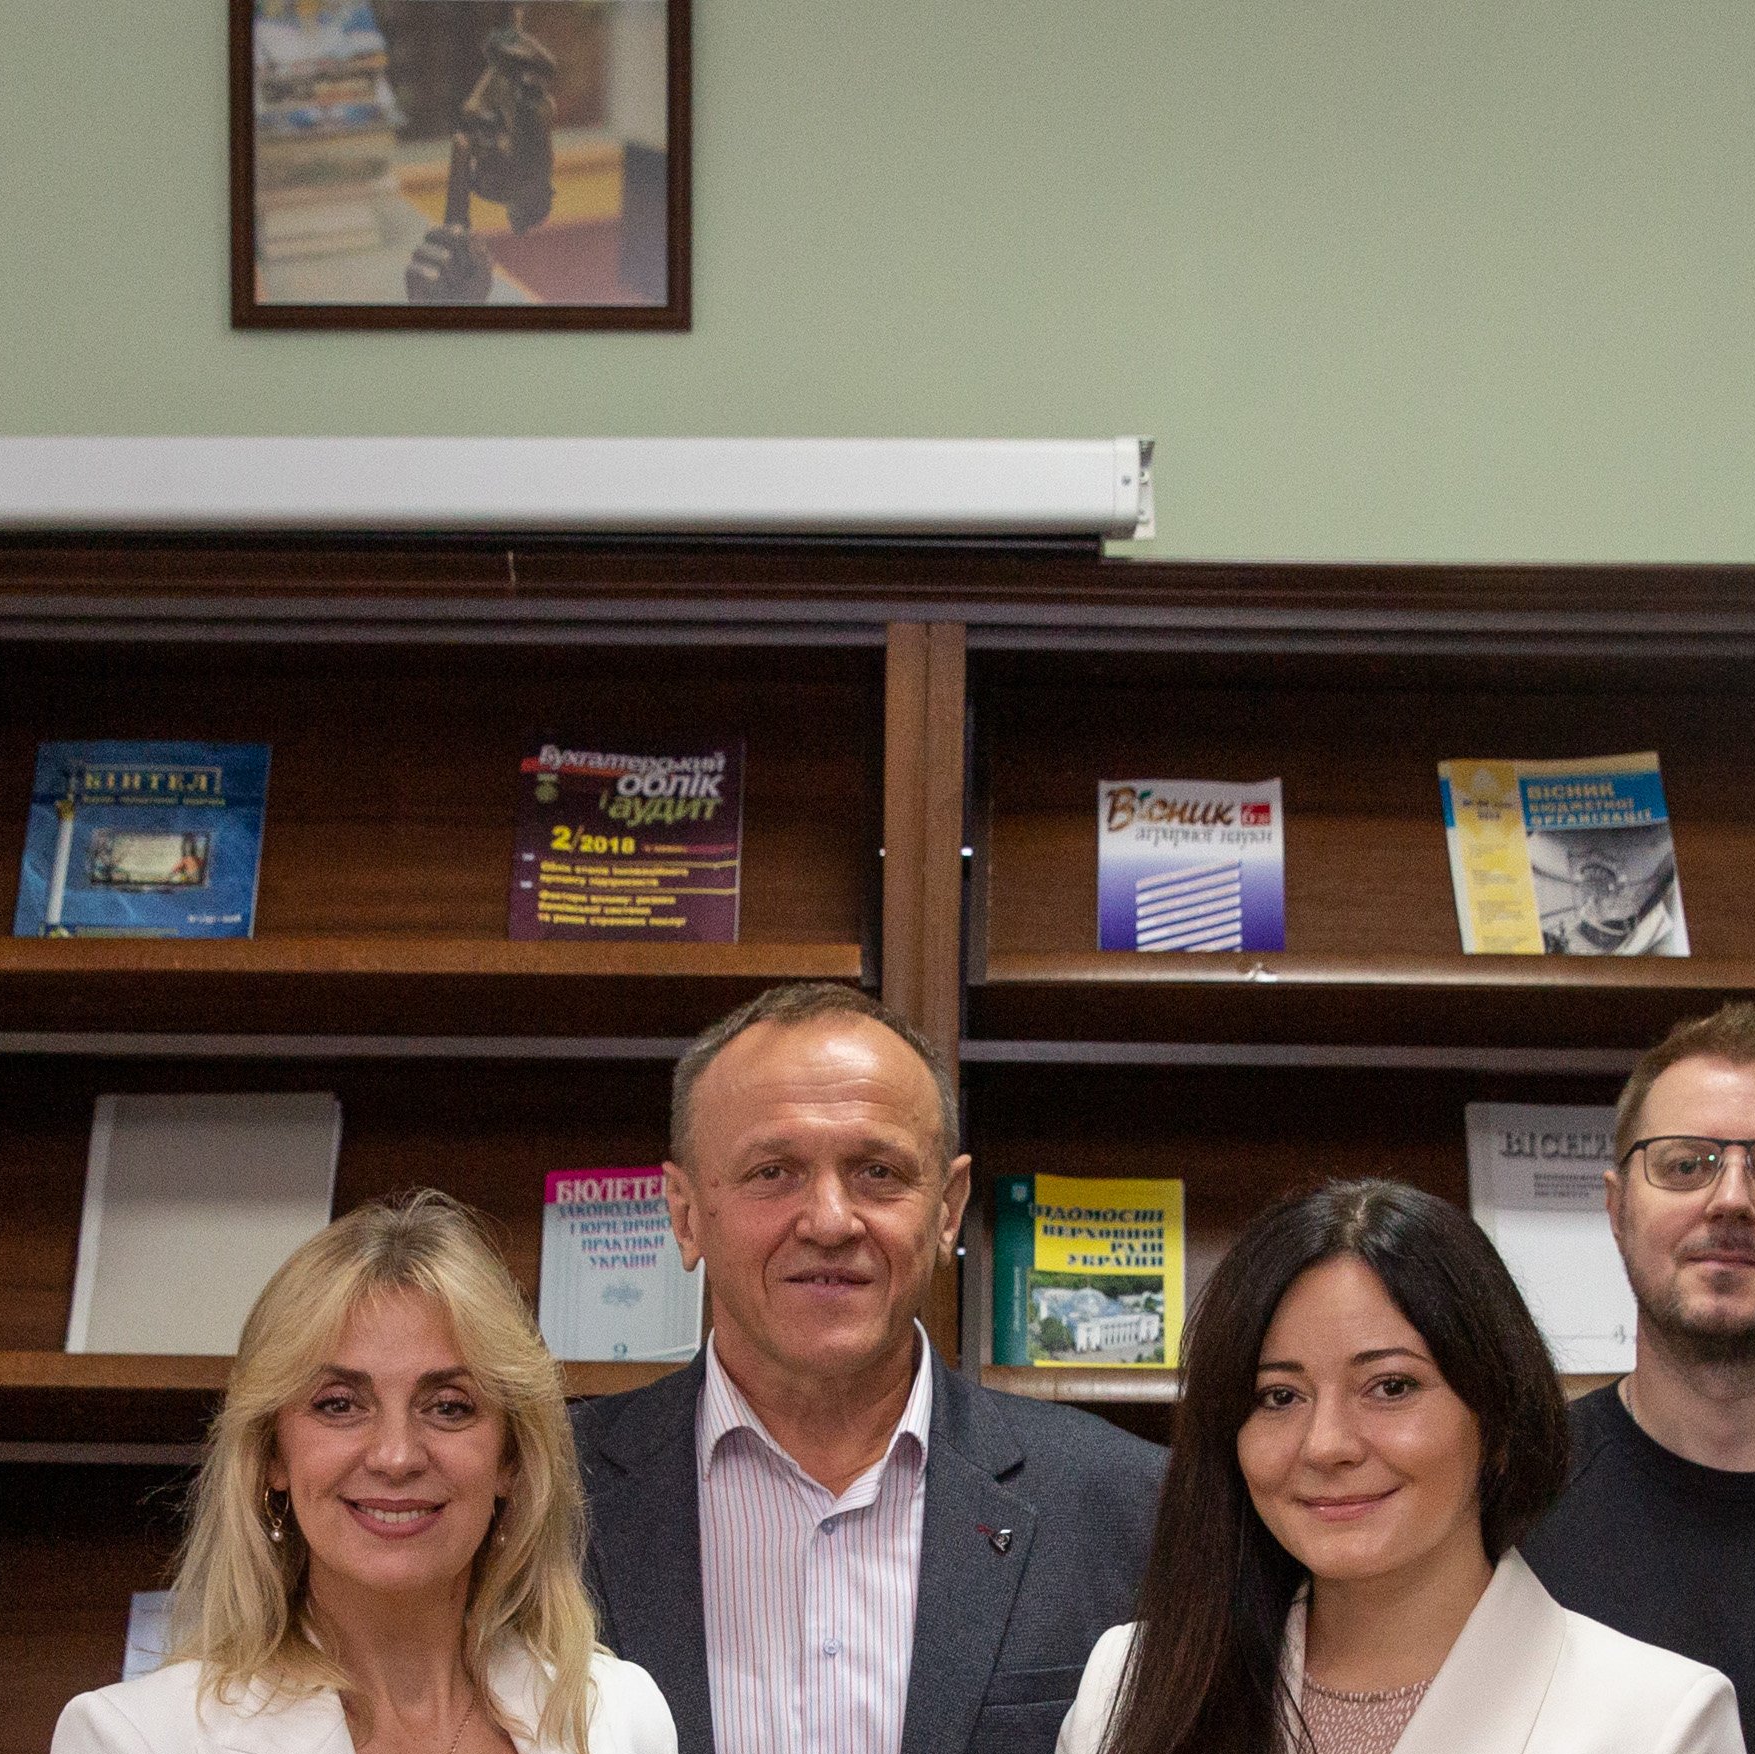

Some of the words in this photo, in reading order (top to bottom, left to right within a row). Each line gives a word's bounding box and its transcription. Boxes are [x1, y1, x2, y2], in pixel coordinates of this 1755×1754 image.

[539, 744, 726, 774] Бухгалтерський
[616, 773, 724, 798] облік
[1527, 783, 1615, 800] ВІСНИК
[608, 797, 723, 828] аудит
[1106, 786, 1234, 833] Вісник
[550, 824, 636, 855] 2/2018
[555, 1175, 667, 1204] БЮЛЕТЕ
[1042, 1224, 1164, 1240] ВЕРХОВНОЇ
[1067, 1254, 1164, 1268] УКРАЇНИ
[1110, 1242, 1164, 1254] РАДИ
